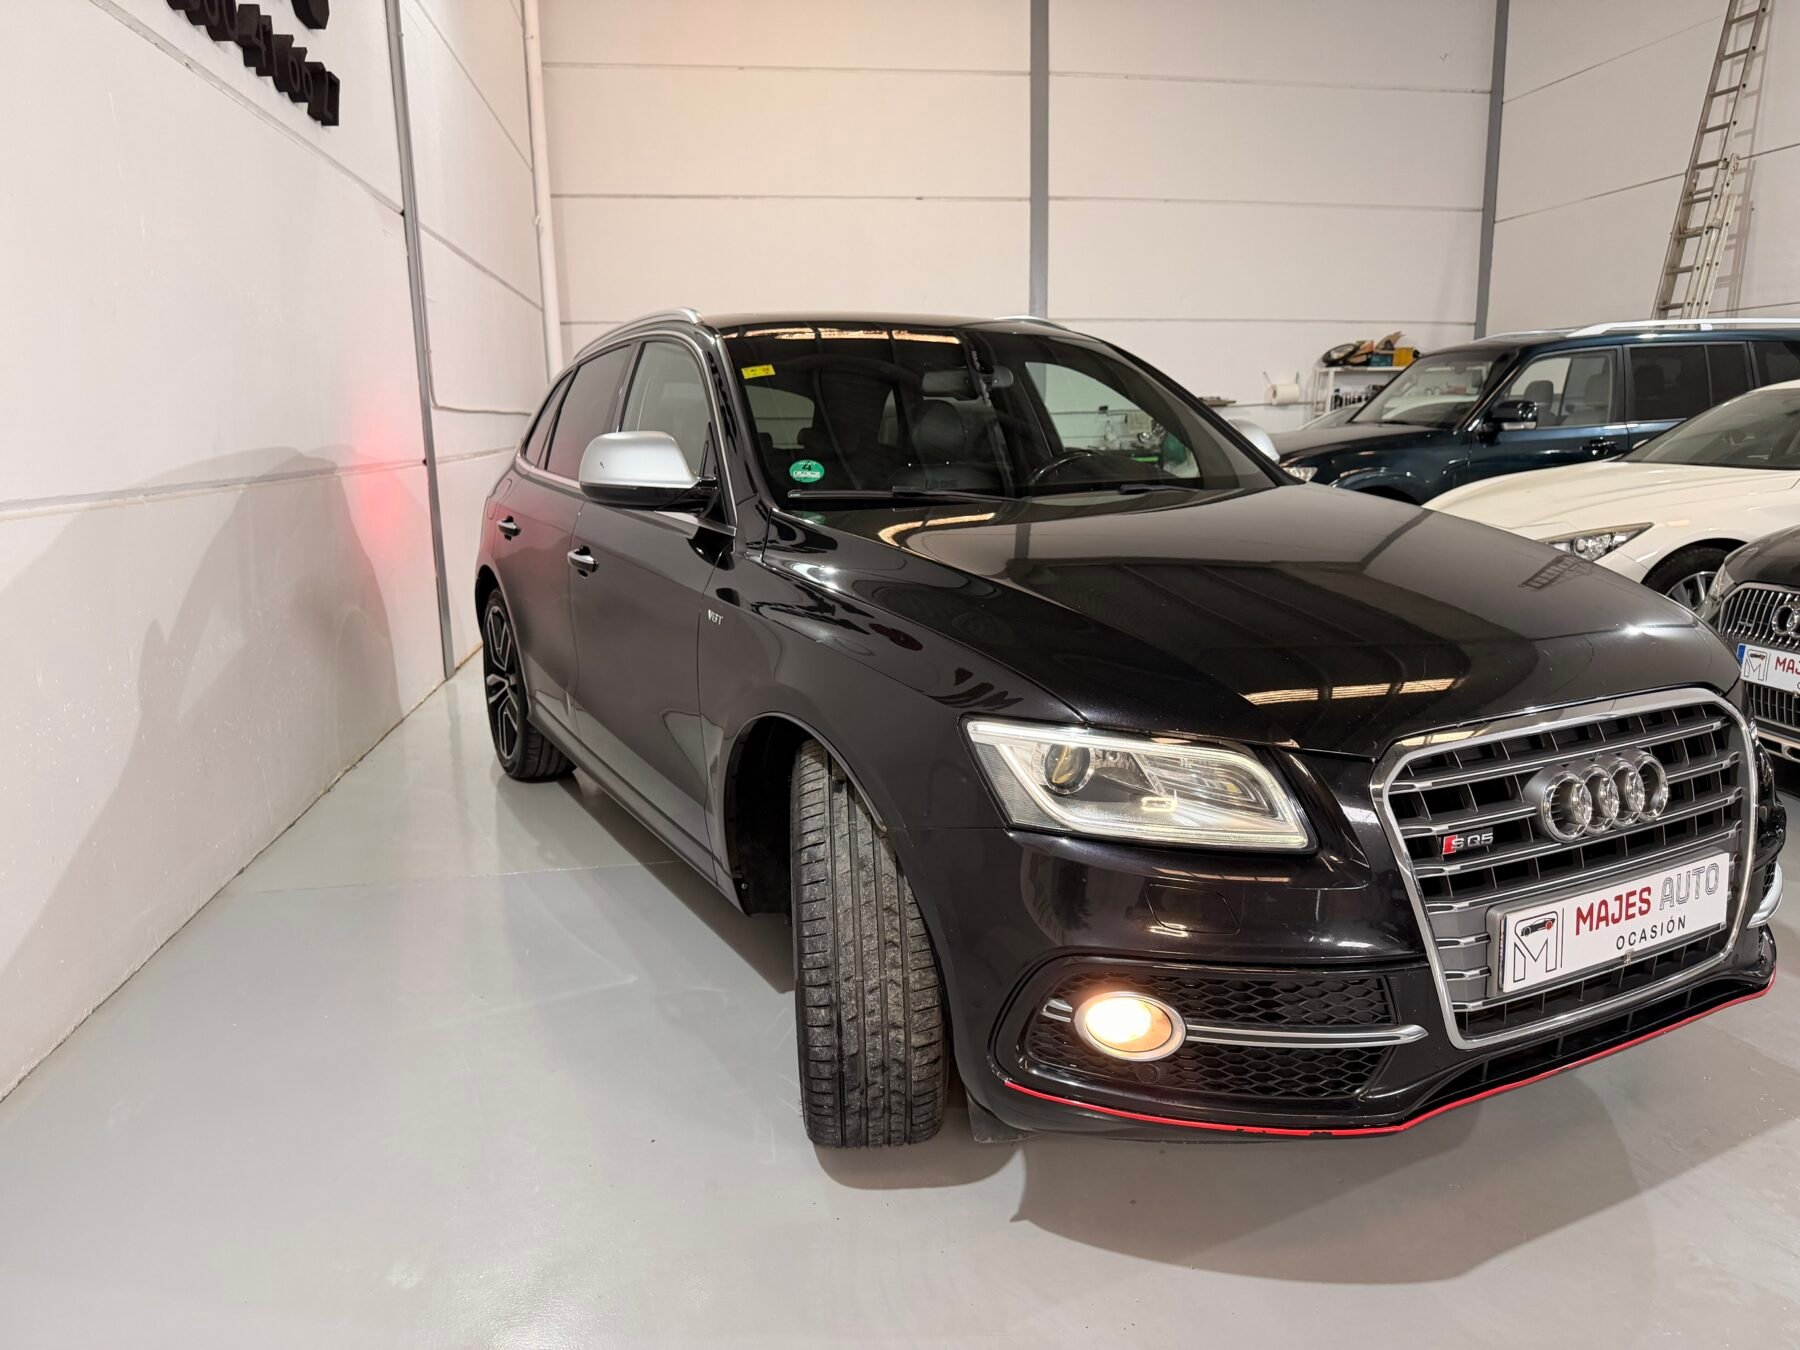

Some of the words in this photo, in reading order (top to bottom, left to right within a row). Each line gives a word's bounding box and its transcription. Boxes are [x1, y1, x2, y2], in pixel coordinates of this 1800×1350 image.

[1575, 886, 1652, 936] MAJES
[1659, 862, 1720, 911] AUTO
[1616, 915, 1686, 950] OCASIÓN
